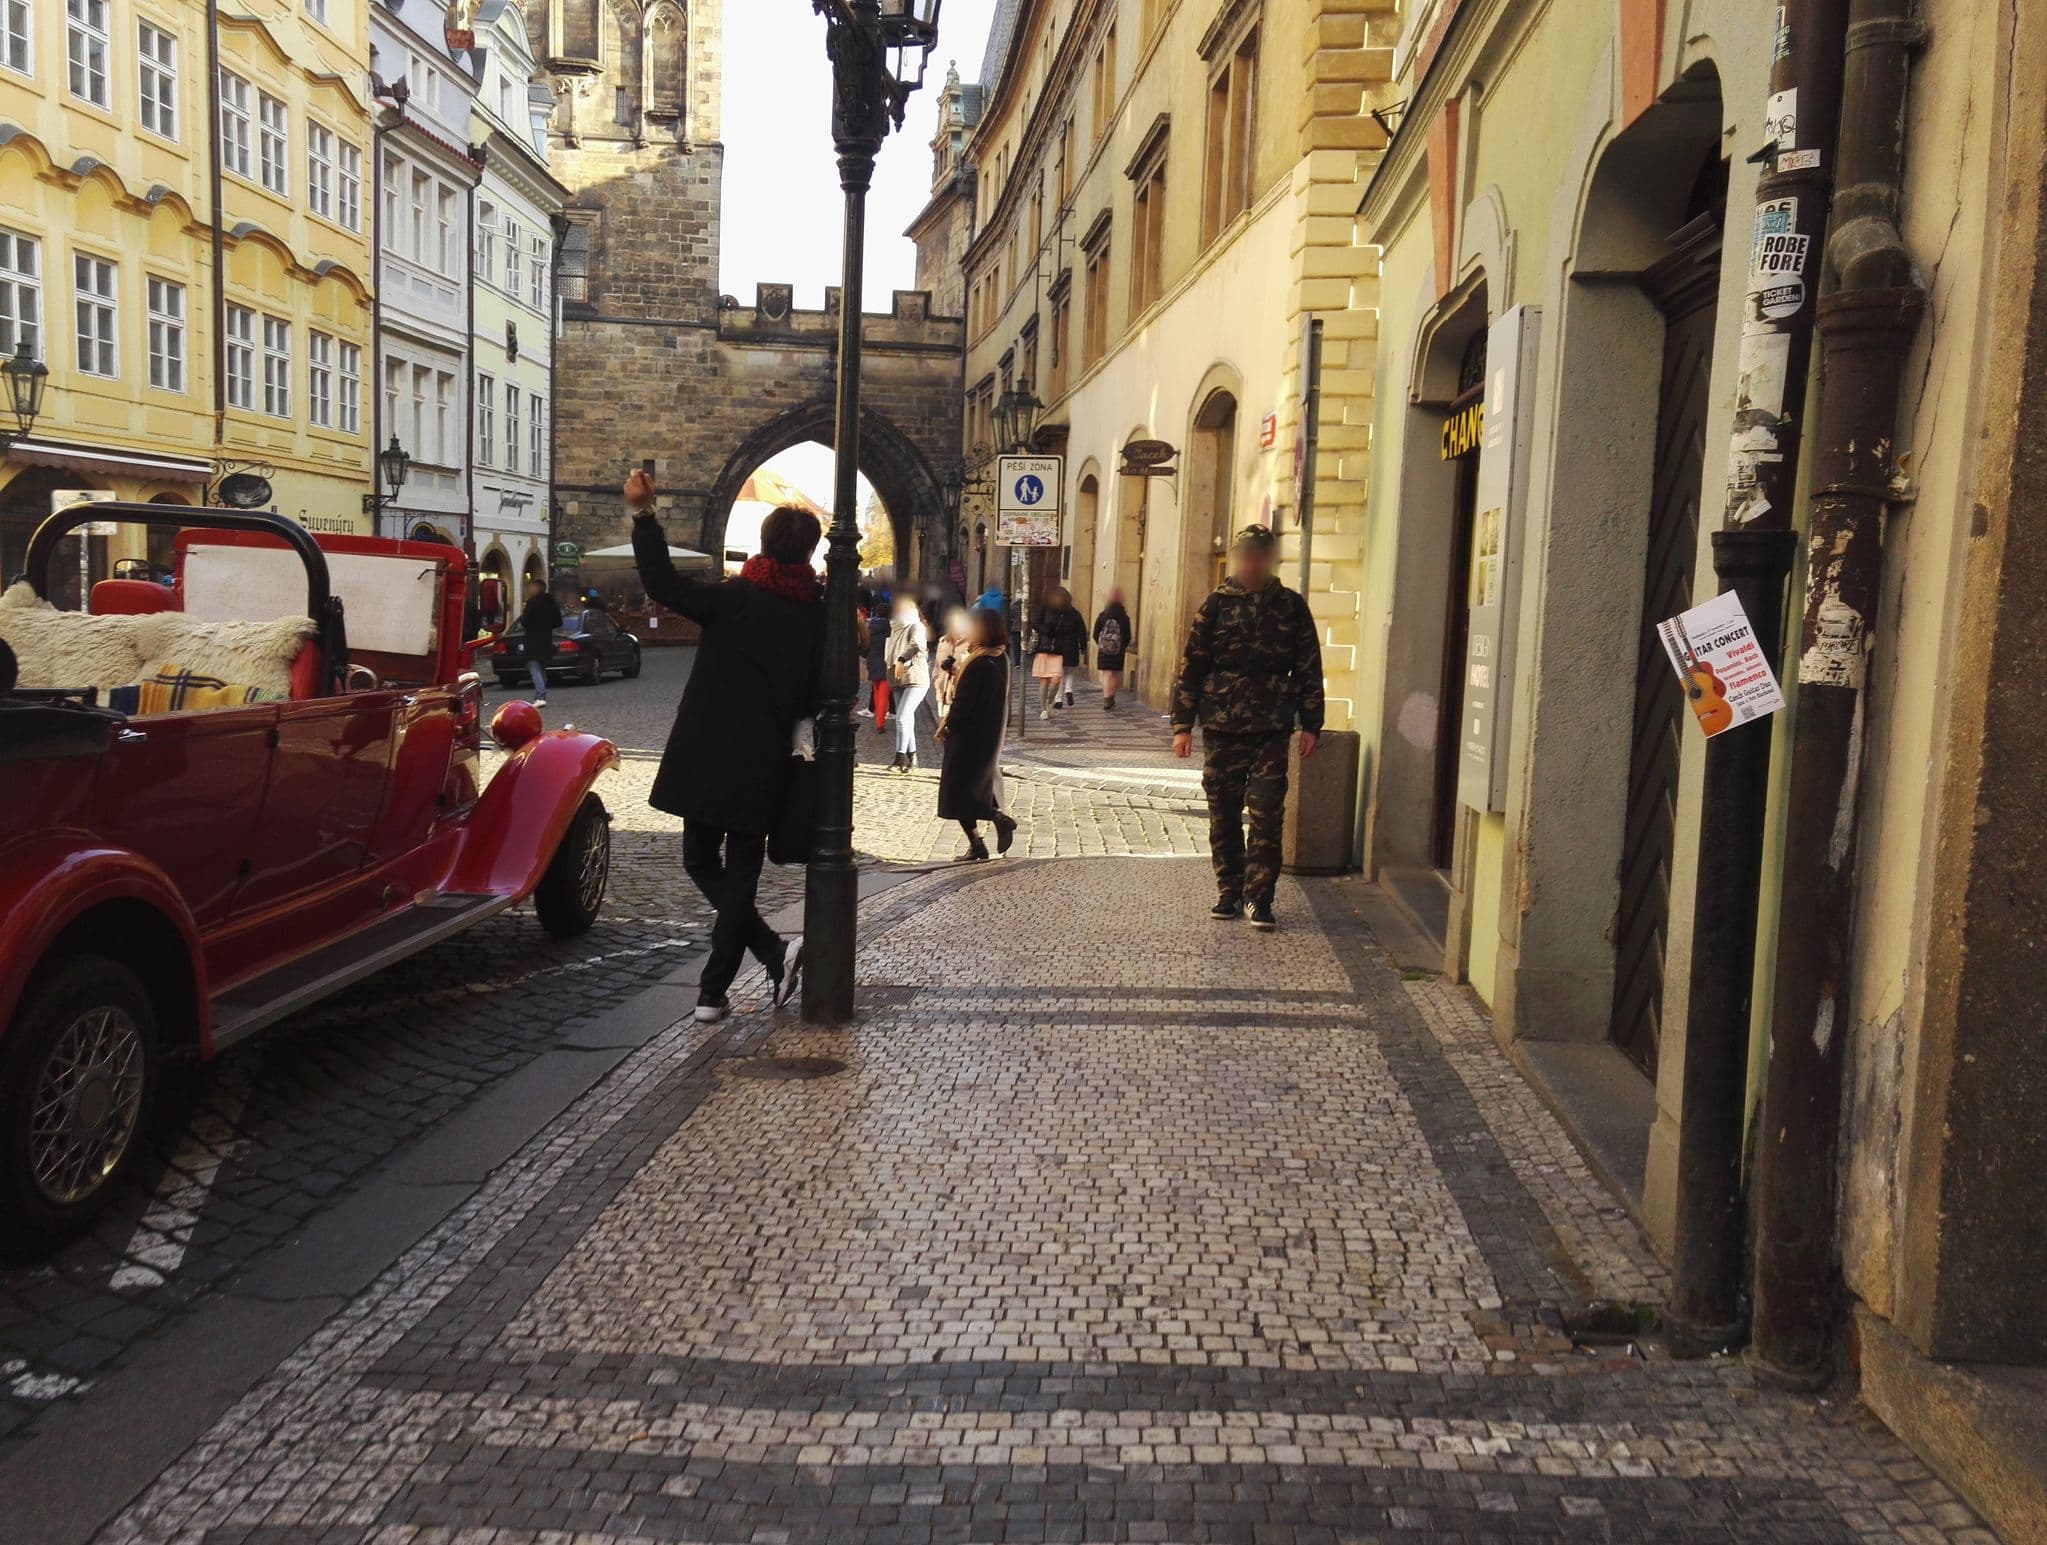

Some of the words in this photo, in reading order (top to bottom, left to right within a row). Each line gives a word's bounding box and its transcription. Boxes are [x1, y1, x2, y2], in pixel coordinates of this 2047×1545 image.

[1764, 236, 1806, 254] ROBE
[1760, 253, 1802, 271] FORE
[1763, 287, 1792, 299] TICKET
[1713, 626, 1750, 648] CONCERT
[1726, 642, 1755, 659] Vivaldi
[1470, 664, 1489, 688] HOTEL
[1729, 670, 1767, 690] flamenco
